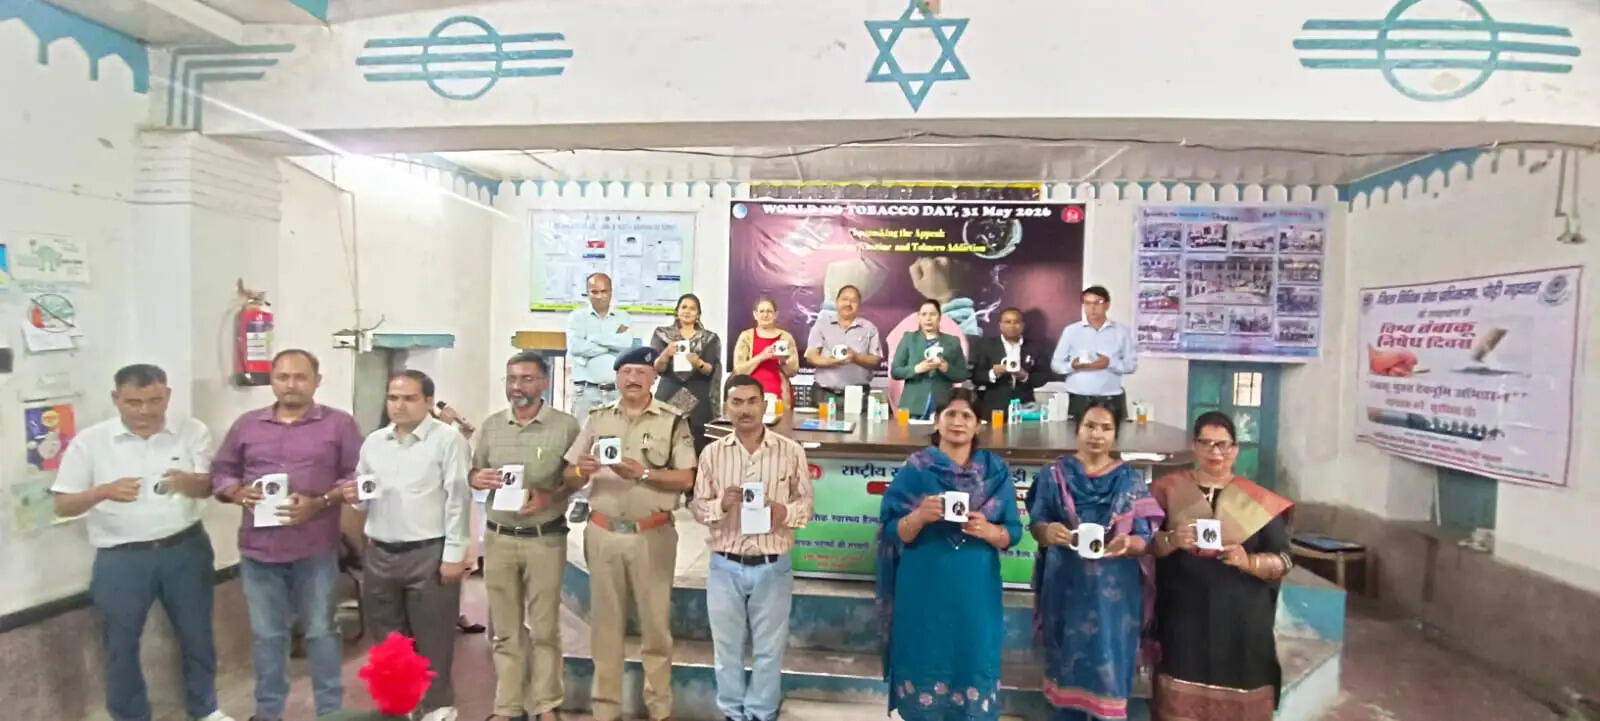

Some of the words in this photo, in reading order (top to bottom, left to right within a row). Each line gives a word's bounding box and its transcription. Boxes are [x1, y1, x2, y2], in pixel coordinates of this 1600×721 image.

[762, 204, 820, 215] WORLD
[822, 204, 844, 216] NO
[848, 205, 920, 216] TOBACCO
[922, 206, 959, 218] DAY,
[961, 207, 979, 217] 31
[982, 206, 1012, 218] May
[1015, 207, 1052, 218] 2026
[894, 243, 911, 252] and
[911, 242, 946, 252] Tobacco
[947, 243, 986, 252] Addiction
[1380, 322, 1414, 335] विश्व
[1376, 333, 1422, 349] निषेध
[1426, 335, 1473, 350] दिवस
[842, 463, 886, 478] राष्ट्रीय
